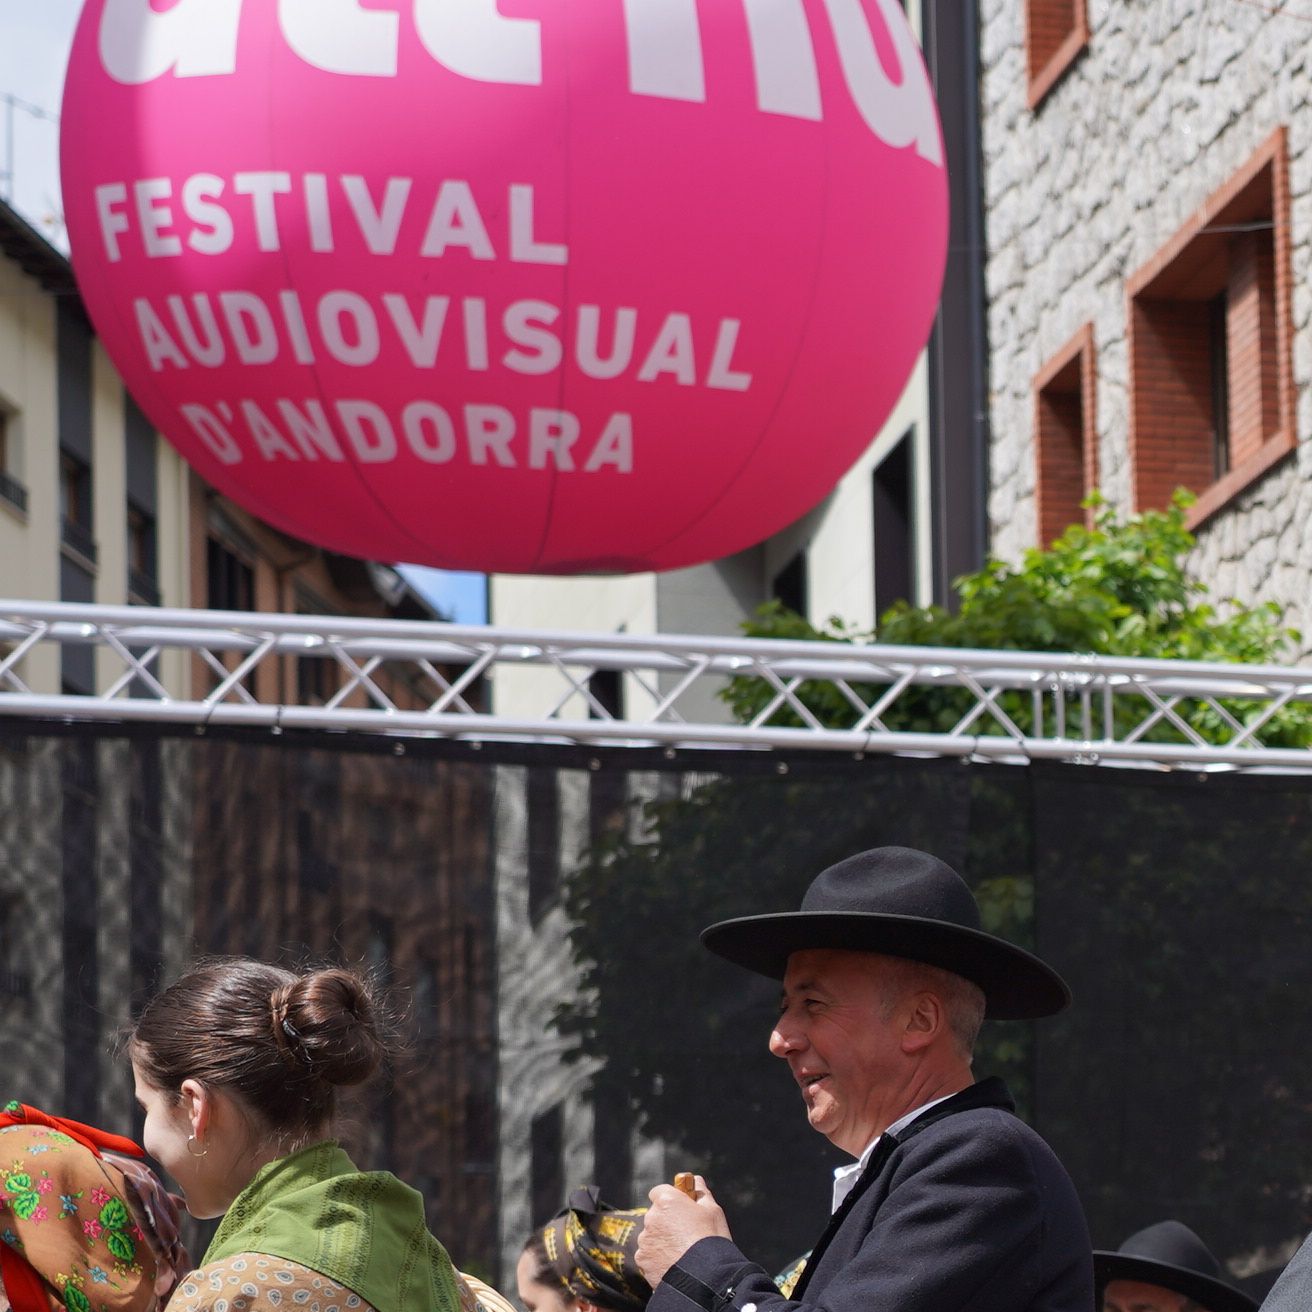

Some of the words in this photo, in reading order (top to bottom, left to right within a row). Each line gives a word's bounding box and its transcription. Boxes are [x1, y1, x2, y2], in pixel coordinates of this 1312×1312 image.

[95, 171, 569, 266] FESTIVAL
[133, 290, 752, 392] AUDIOVISUAL
[181, 400, 634, 474] D'ANDORRA
